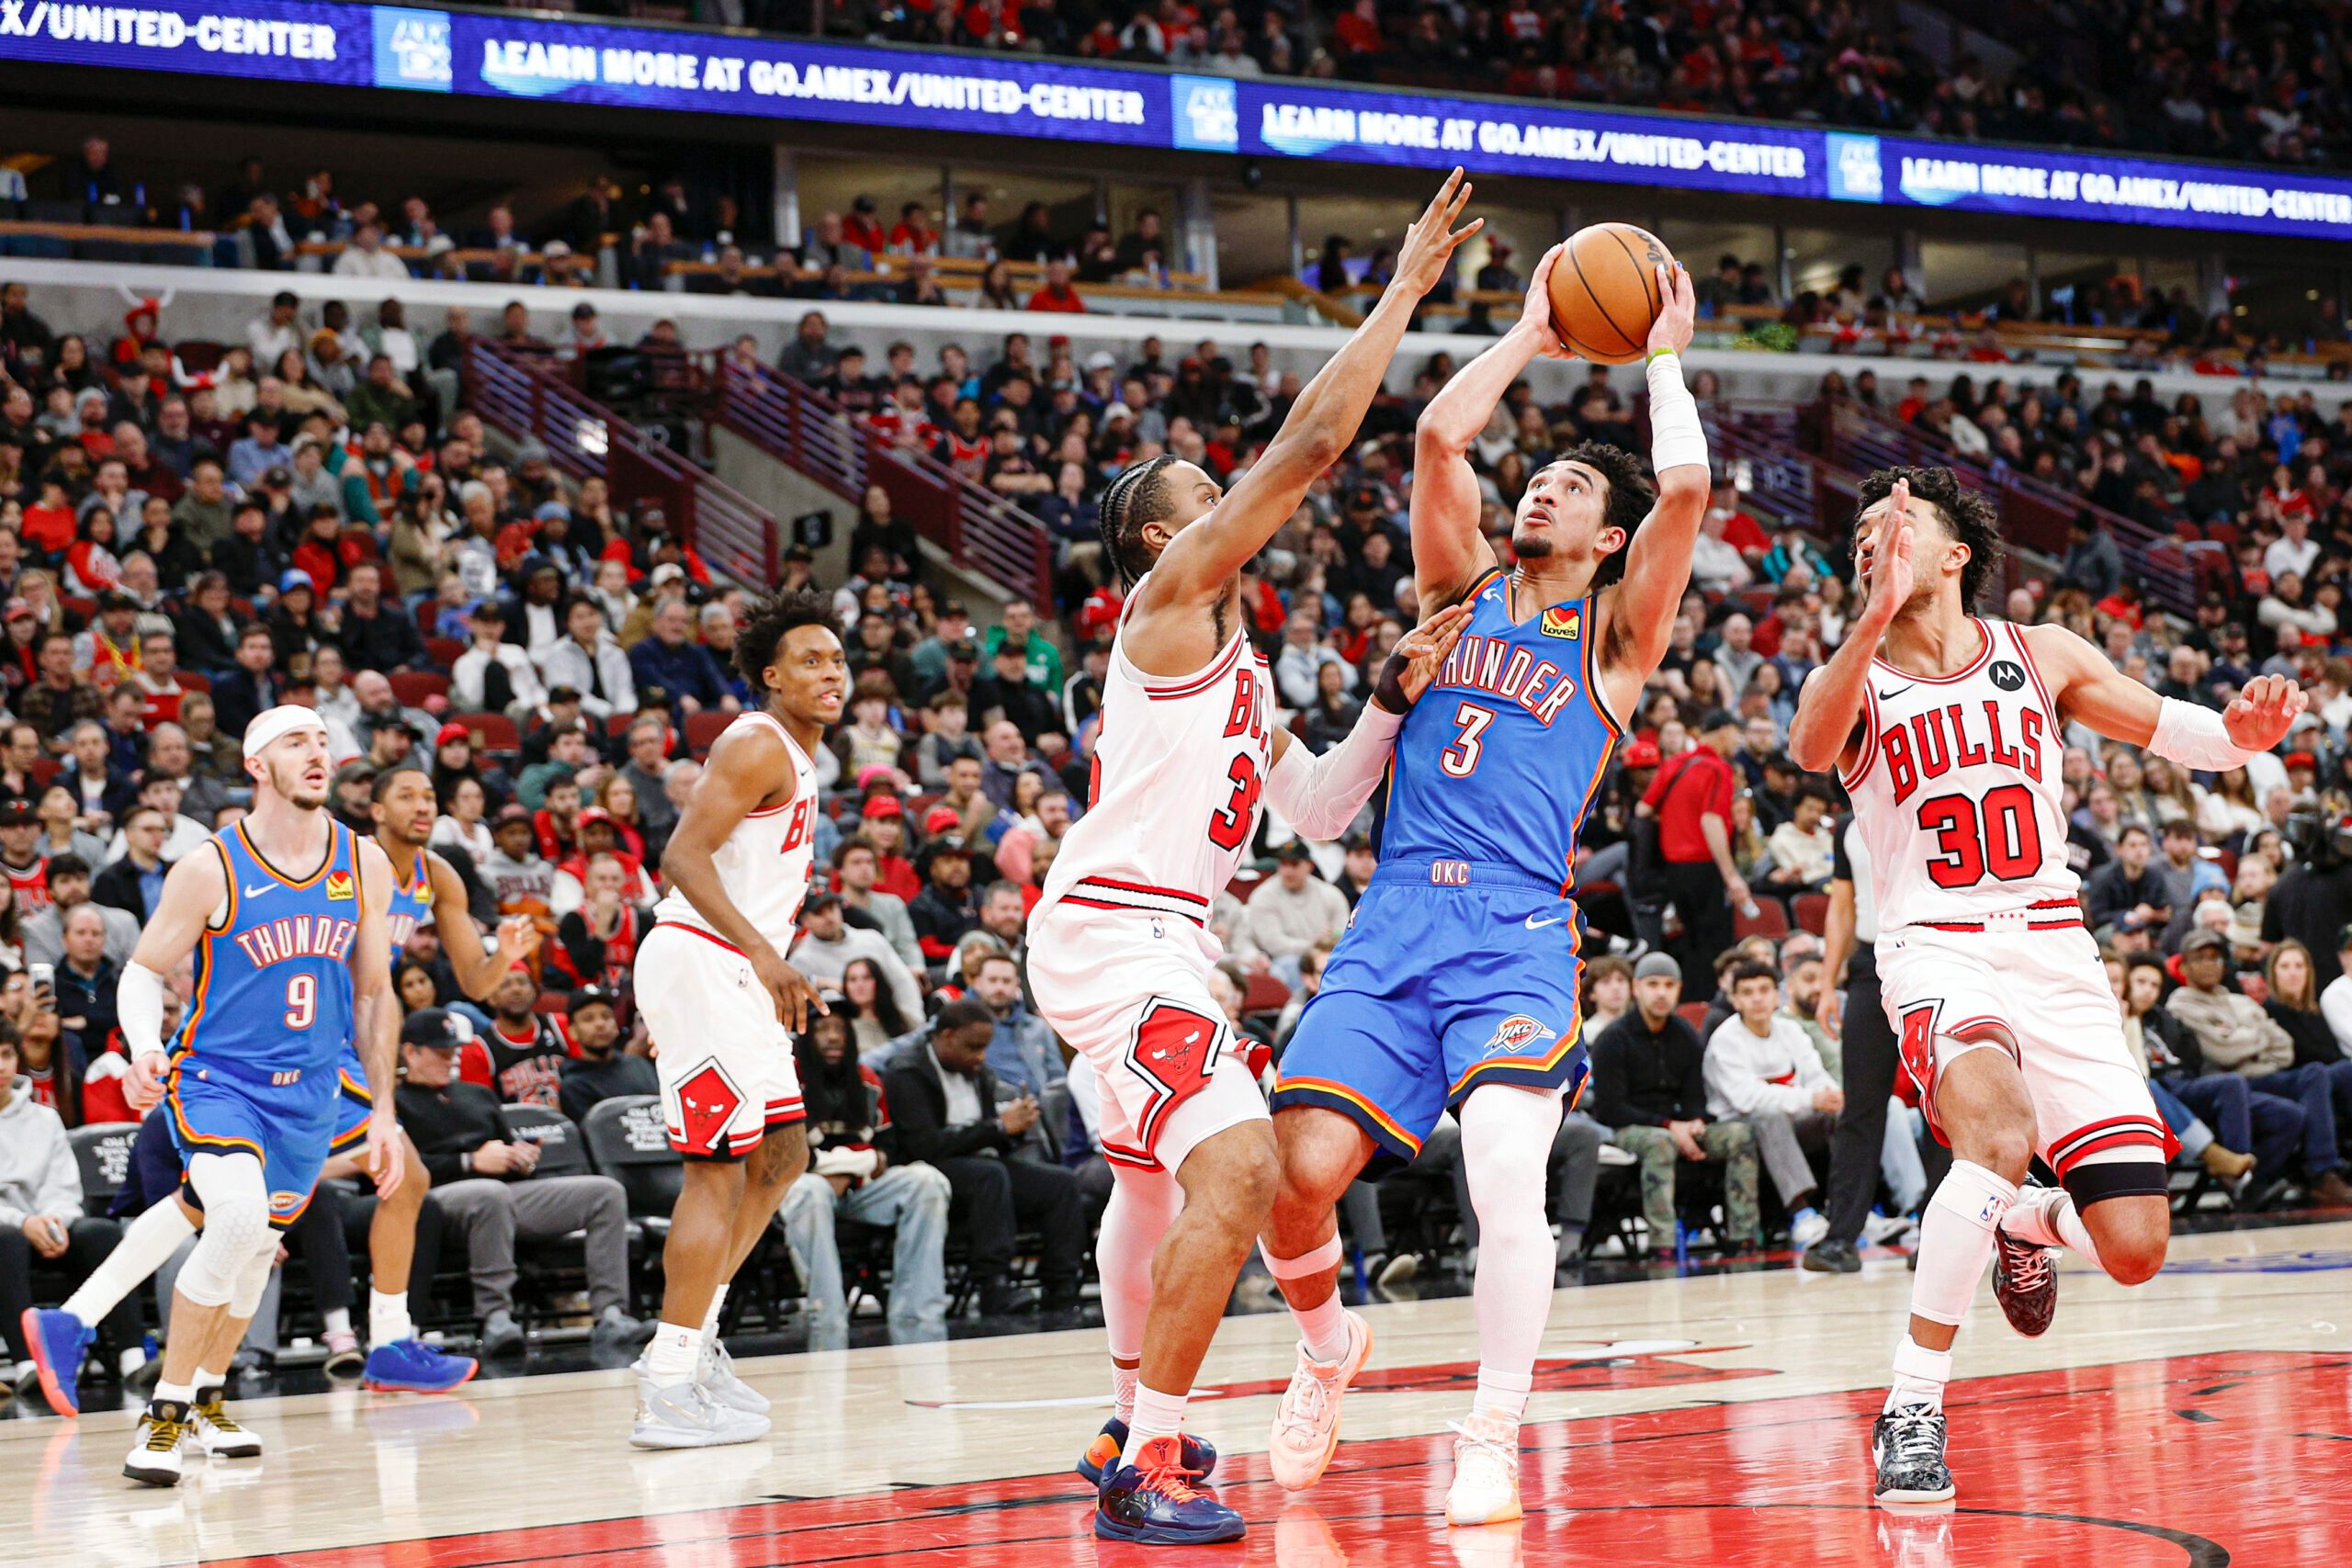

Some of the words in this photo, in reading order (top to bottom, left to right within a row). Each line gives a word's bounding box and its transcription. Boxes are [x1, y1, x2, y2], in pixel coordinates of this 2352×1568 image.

[484, 39, 596, 83] LEARN
[603, 48, 700, 90] MORE
[703, 55, 745, 93] AT
[748, 59, 1146, 125] GO.AMEX/UNITED-CENTER
[1262, 102, 1356, 142] LEARN
[1358, 110, 1440, 149] MORE
[1441, 118, 1476, 151] AT
[1477, 120, 1806, 178] GO.AMEX/UNITED-CENTER
[1901, 156, 1980, 193] LEARN
[1981, 164, 2049, 199] MORE
[2049, 170, 2080, 201] AT
[1432, 635, 1577, 728] HUNDER
[1440, 700, 1497, 778] 3
[1880, 700, 2043, 807] BULLS
[1430, 860, 1469, 886] OKC
[1917, 784, 2043, 889] 30
[284, 973, 317, 1031] 9
[271, 1068, 301, 1086] OKC
